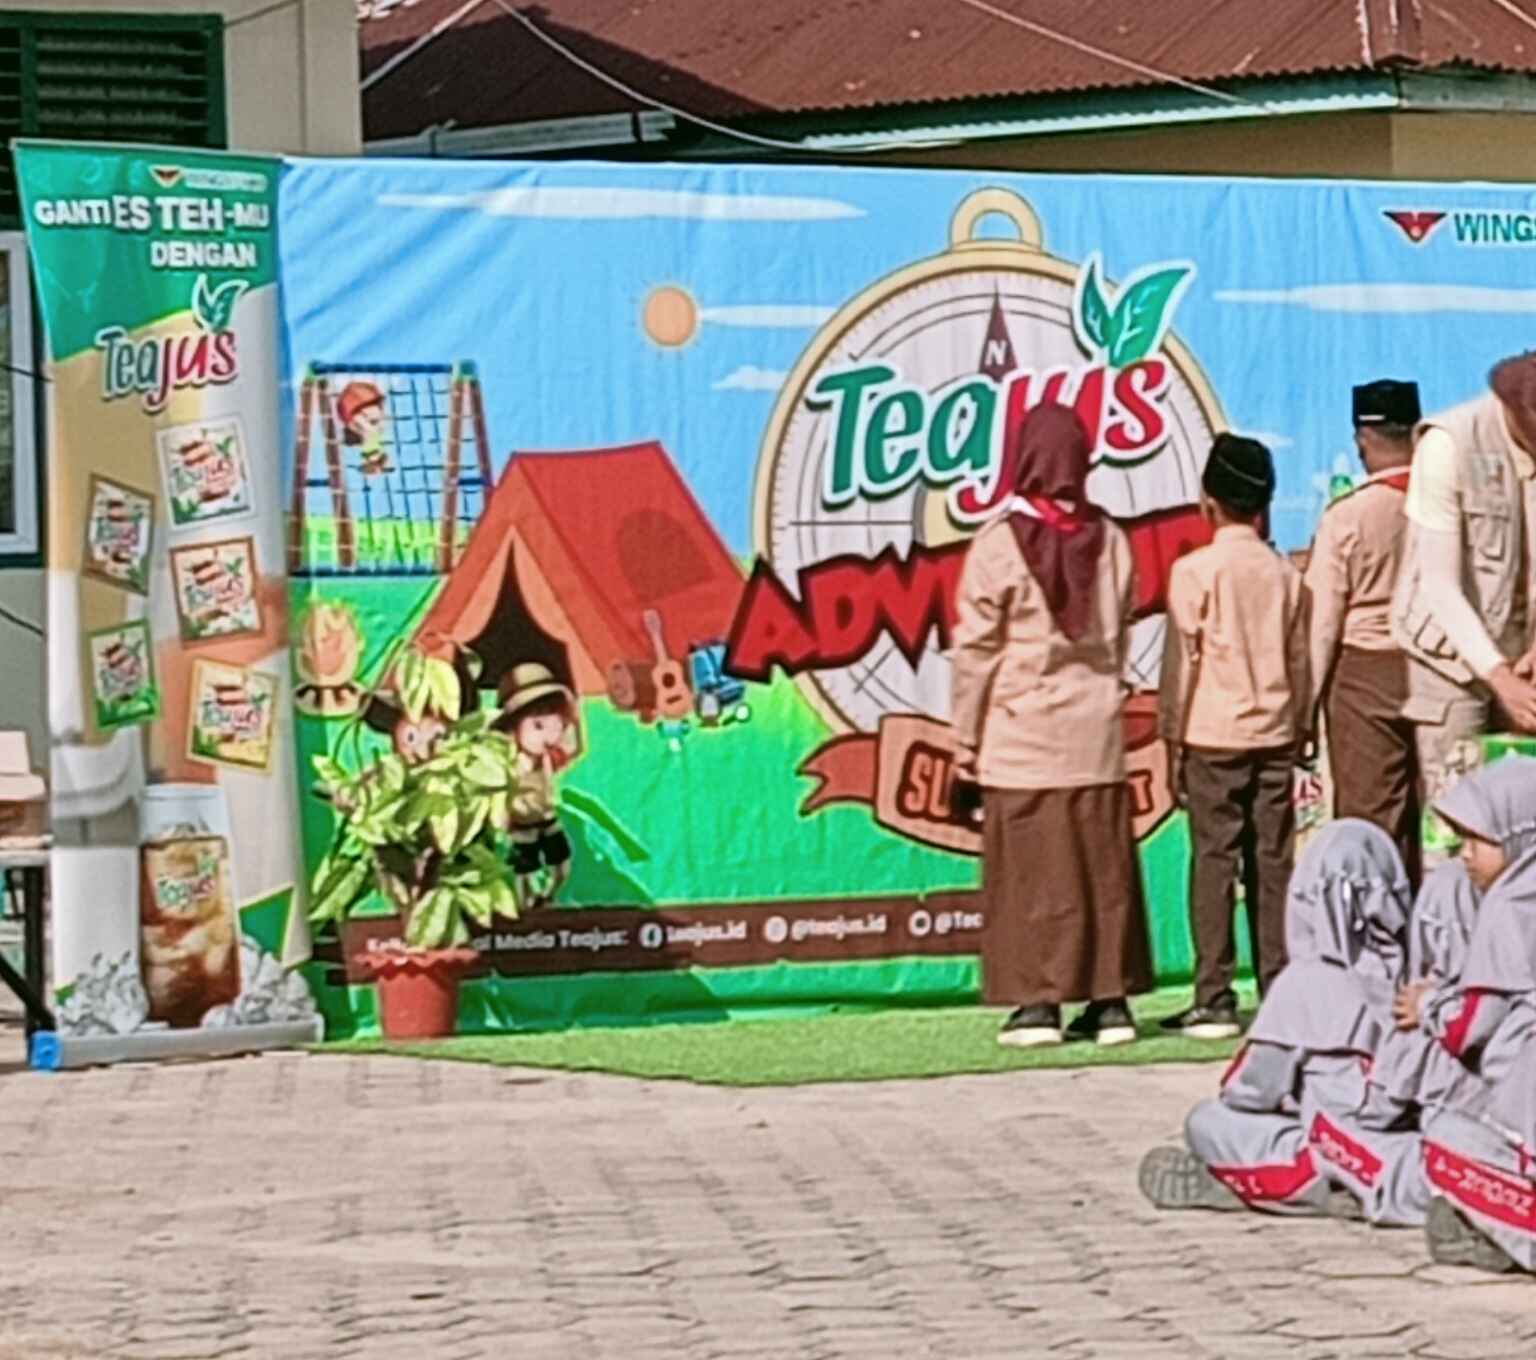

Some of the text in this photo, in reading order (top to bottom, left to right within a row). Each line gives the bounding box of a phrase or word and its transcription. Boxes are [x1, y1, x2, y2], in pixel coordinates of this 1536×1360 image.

[33, 199, 112, 226] GANTI
[112, 196, 151, 231] ES
[151, 242, 256, 267] DENGAN
[985, 340, 1006, 365] N
[97, 328, 238, 409] Teajus
[495, 930, 555, 950] Media
